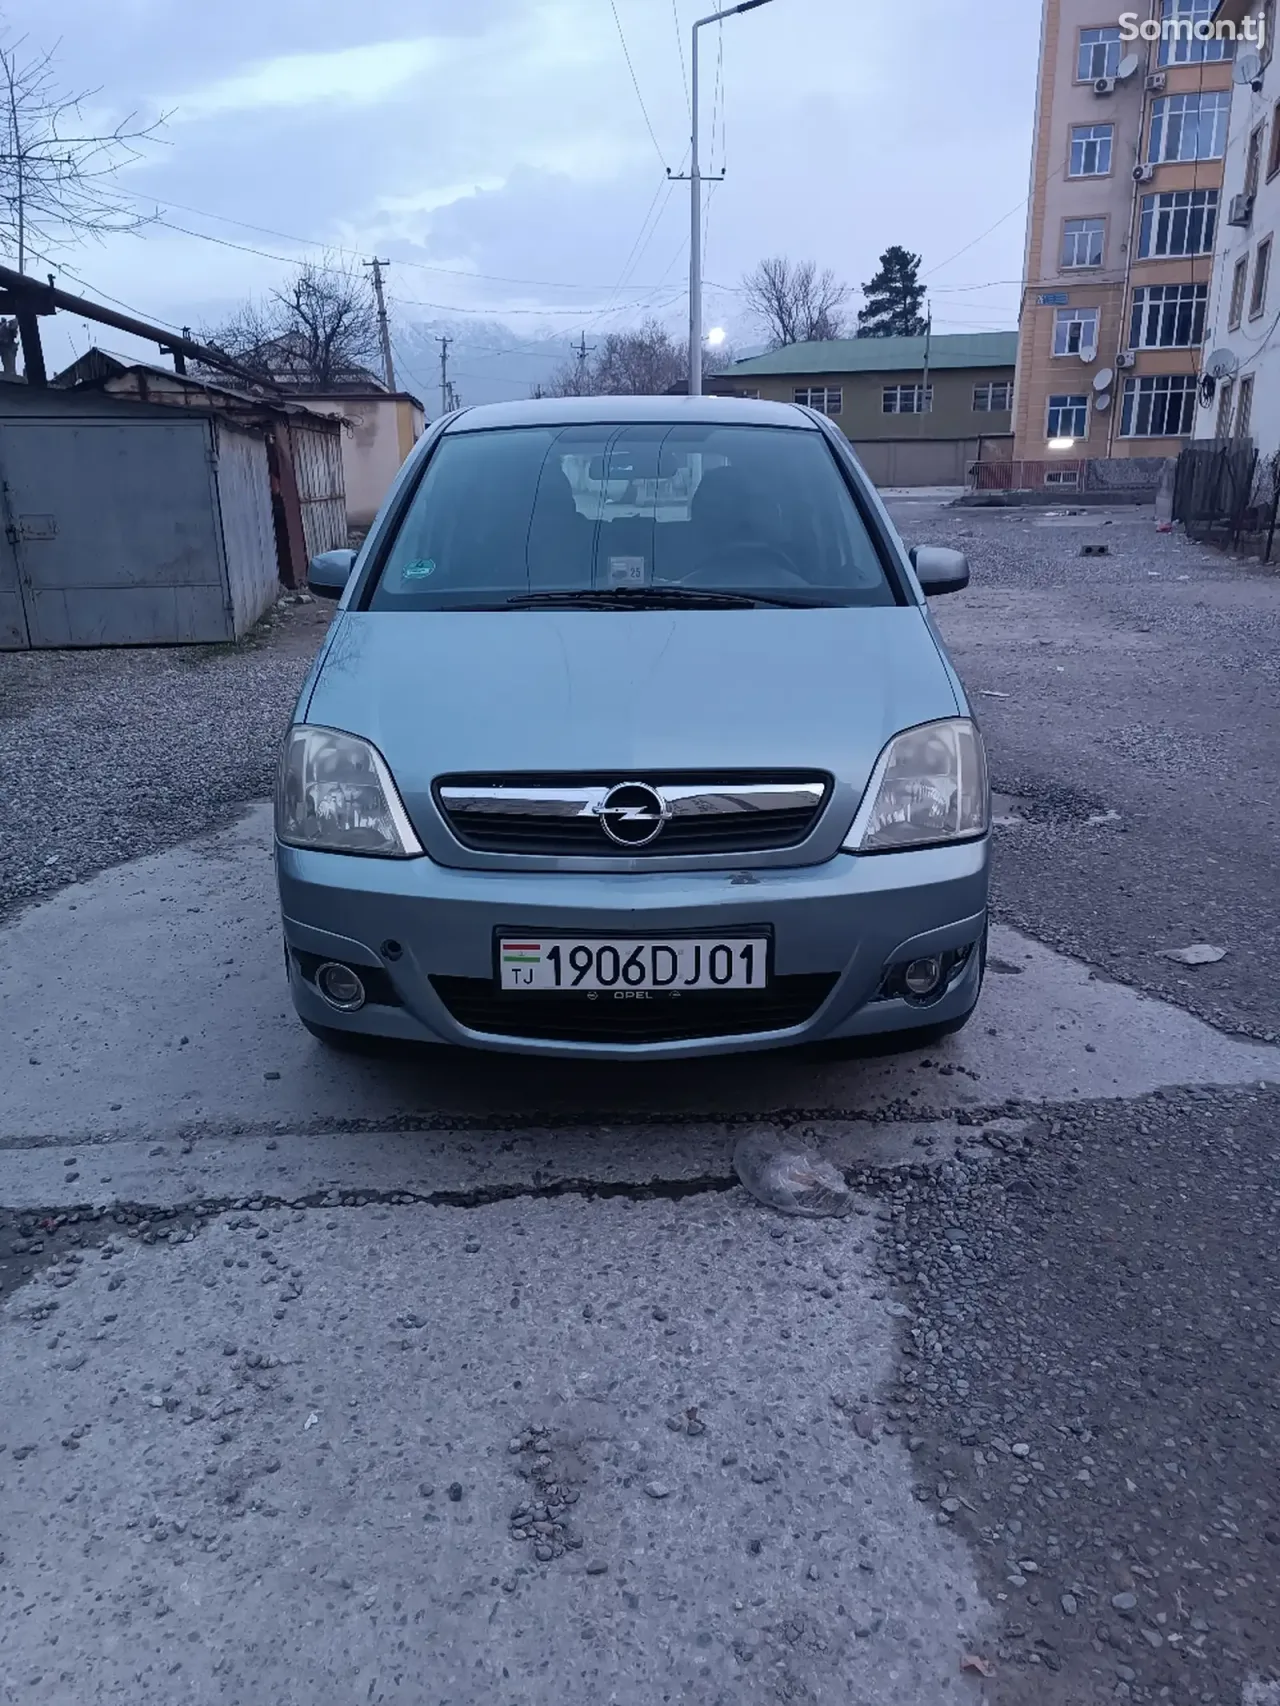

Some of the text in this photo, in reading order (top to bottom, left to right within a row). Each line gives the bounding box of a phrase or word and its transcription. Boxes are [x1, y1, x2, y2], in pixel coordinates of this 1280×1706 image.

[630, 567, 641, 578] 25
[546, 944, 754, 986] 1906DJ01
[511, 968, 534, 985] TJ
[613, 991, 653, 1000] OPEL
